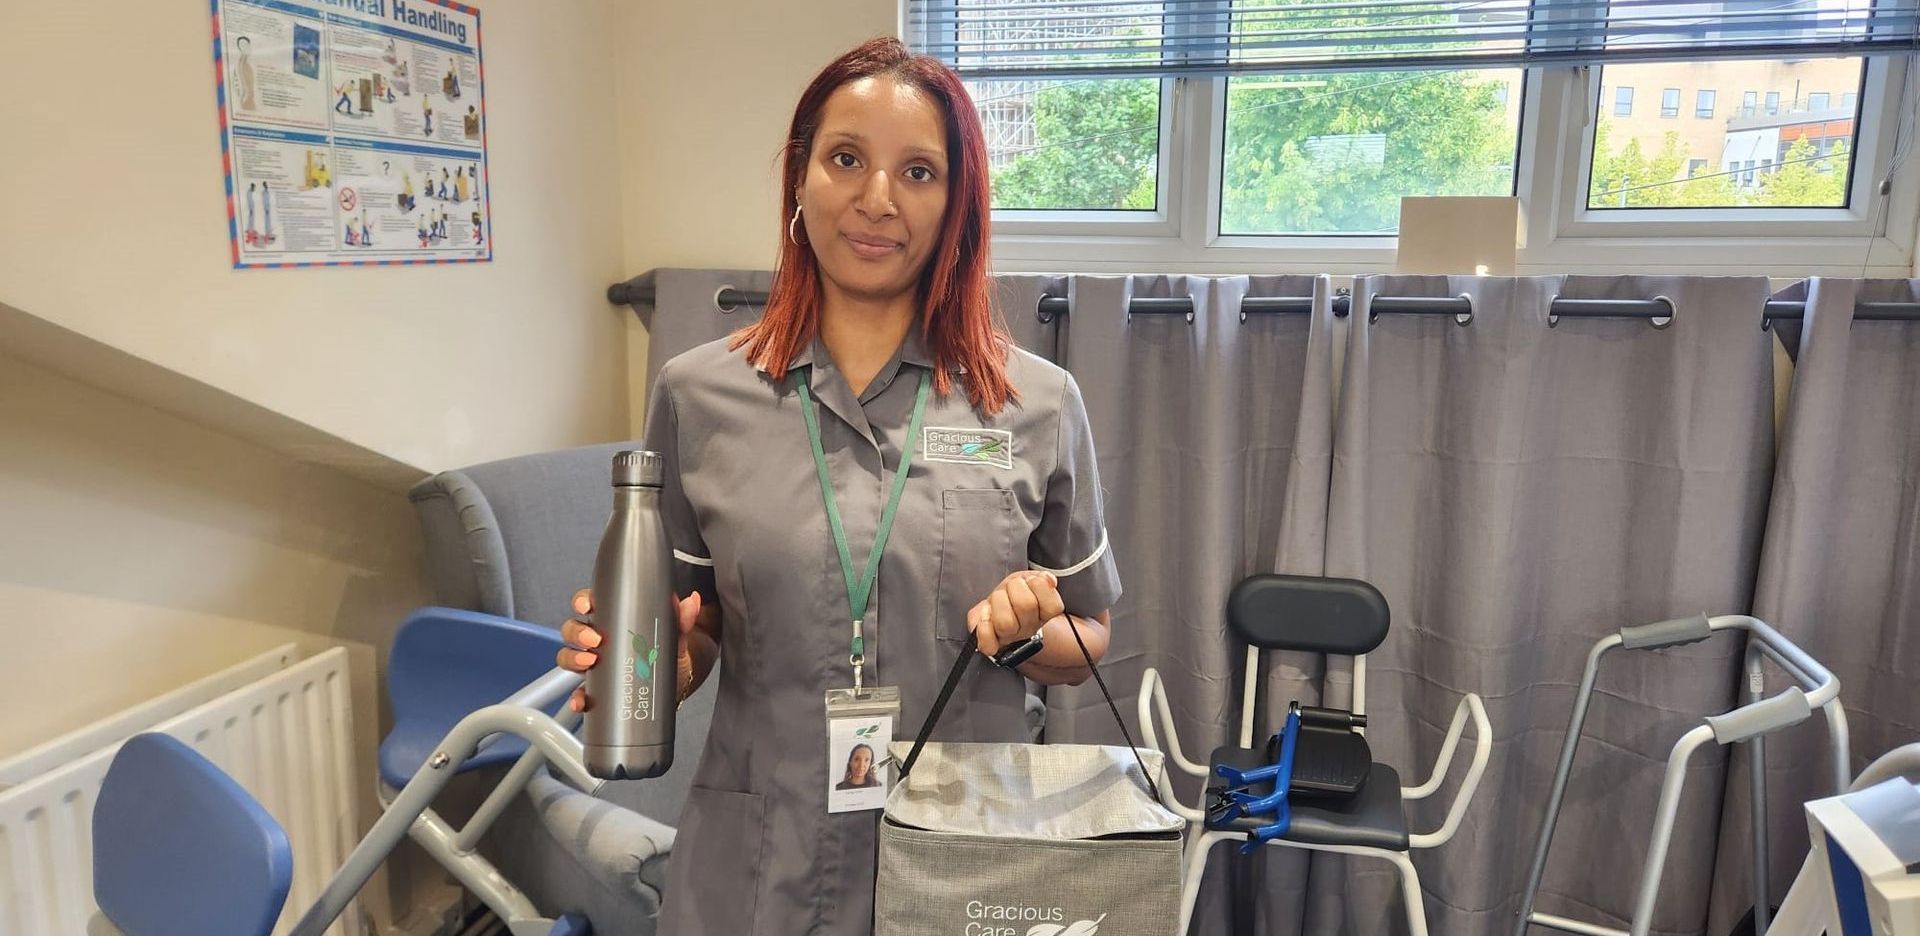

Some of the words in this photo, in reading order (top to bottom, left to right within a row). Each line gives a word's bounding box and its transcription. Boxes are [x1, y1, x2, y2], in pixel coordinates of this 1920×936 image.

[312, 0, 385, 17] ual
[394, 0, 466, 43] Handling
[929, 431, 981, 443] Gracious
[929, 443, 957, 453] Care
[617, 656, 634, 721] Gracious
[634, 685, 649, 720] Care
[966, 900, 1063, 921] Gracious
[965, 921, 1016, 936] Care
